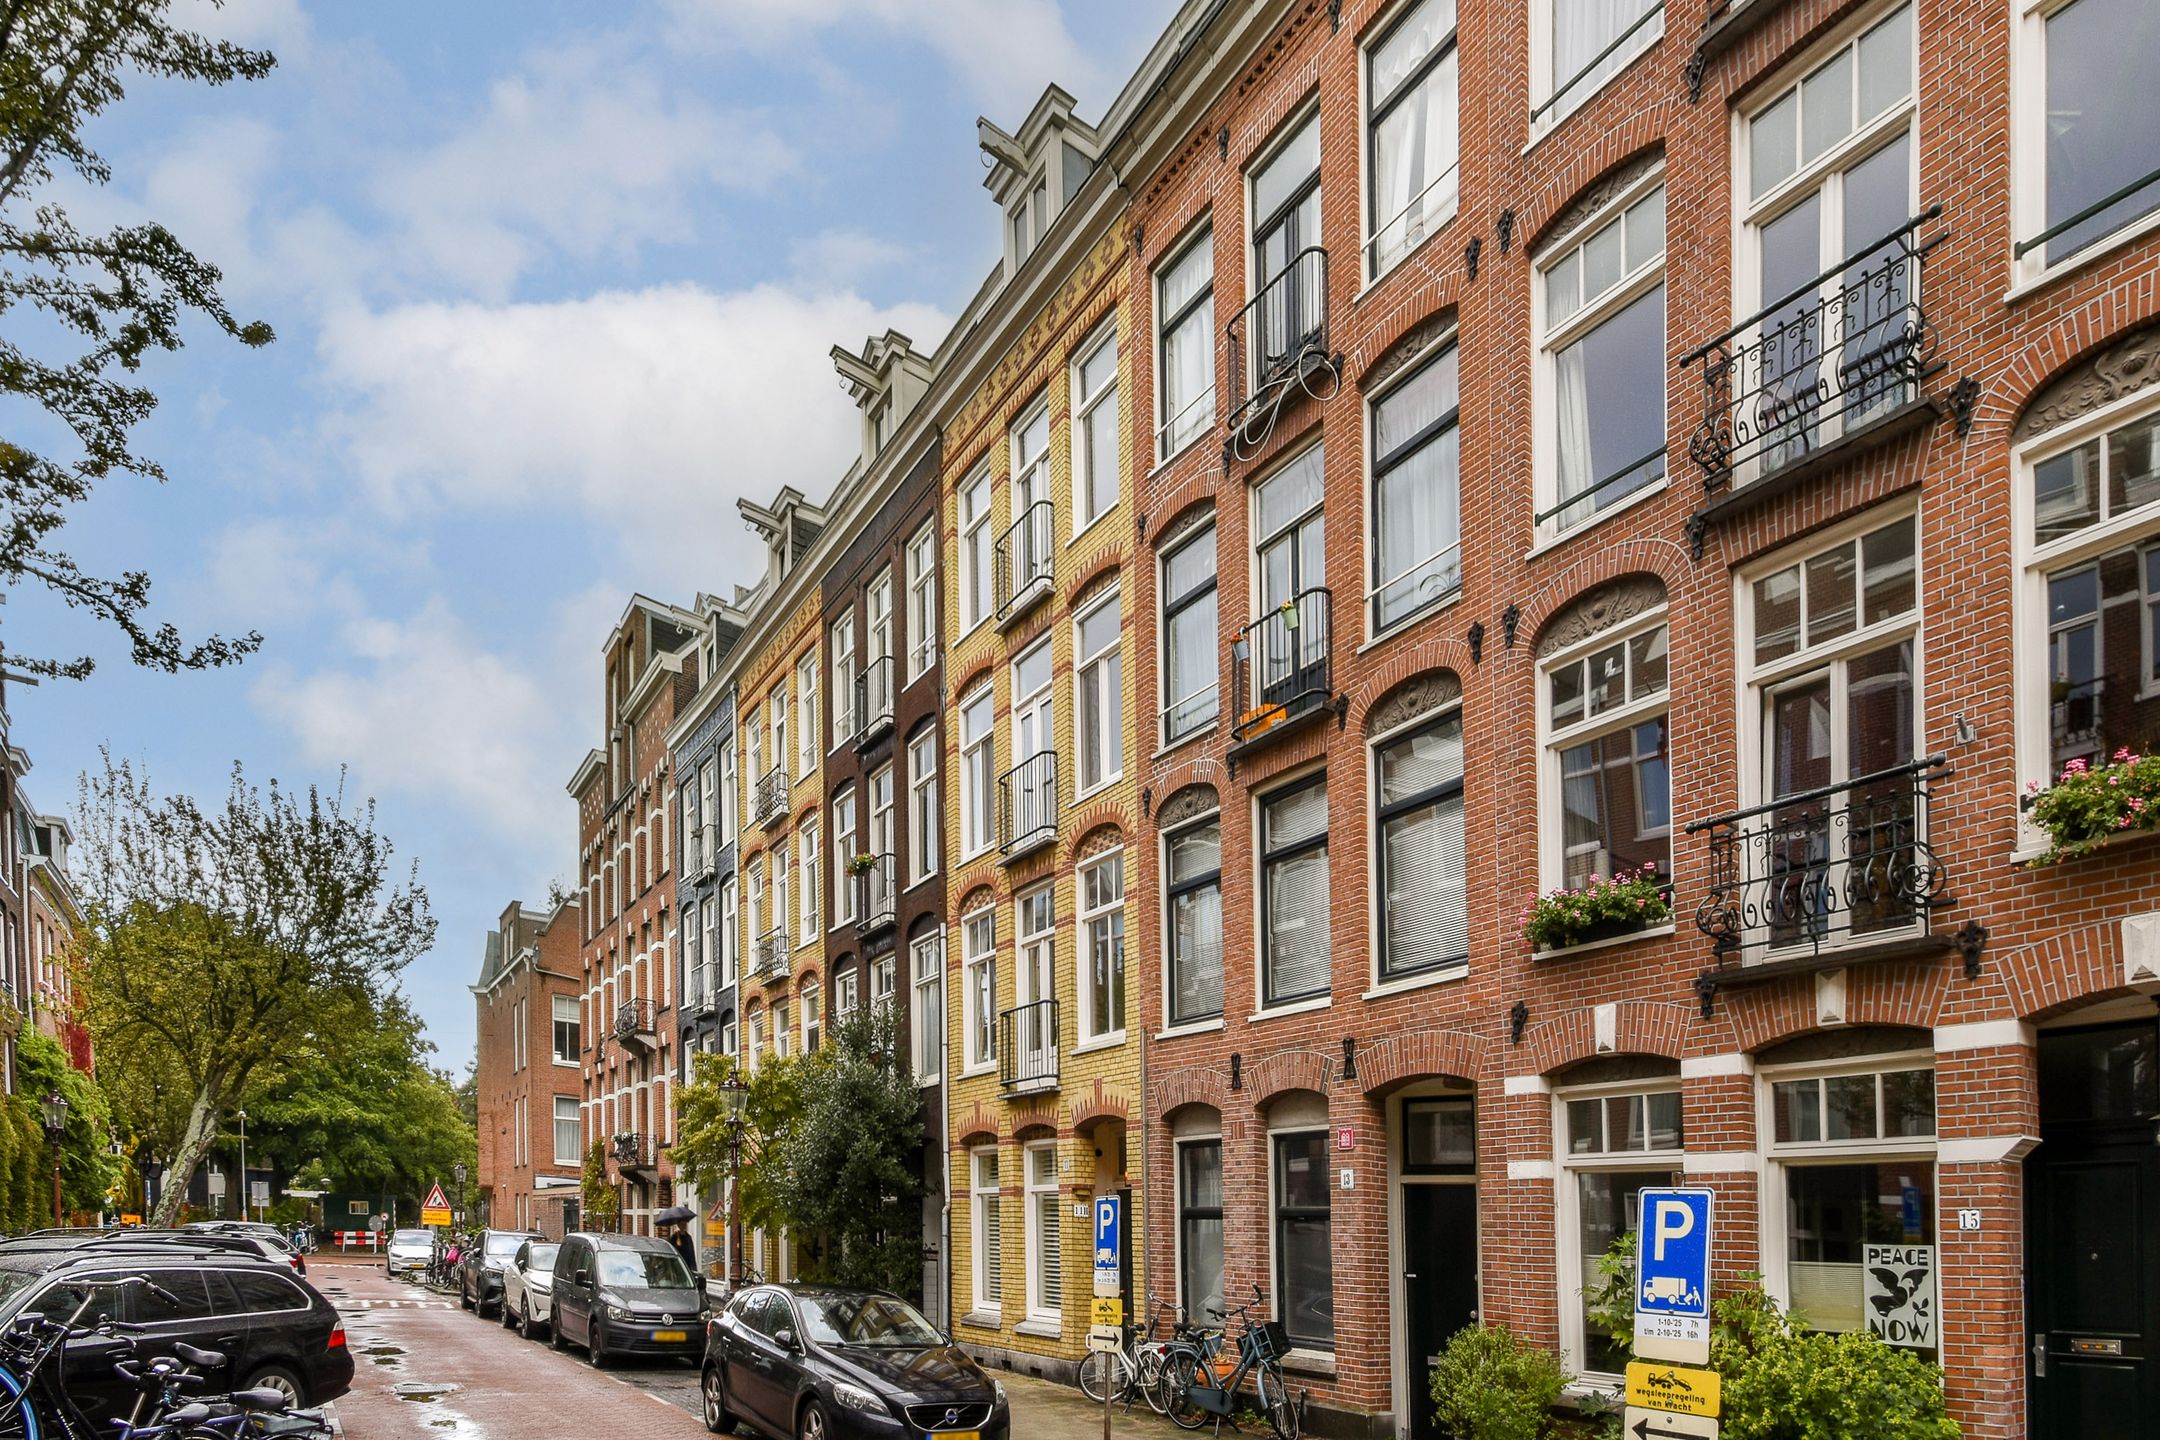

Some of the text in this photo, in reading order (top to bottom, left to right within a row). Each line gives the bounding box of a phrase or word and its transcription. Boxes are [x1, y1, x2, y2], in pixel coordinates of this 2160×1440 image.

[1100, 1203, 1114, 1240] P
[1654, 1200, 1694, 1260] P
[1961, 1213, 1978, 1228] 15
[1868, 1247, 1929, 1266] PEACE
[1870, 1318, 1929, 1343] NOW
[1636, 1388, 1705, 1405] wegsleepregeling
[1647, 1399, 1662, 1407] van
